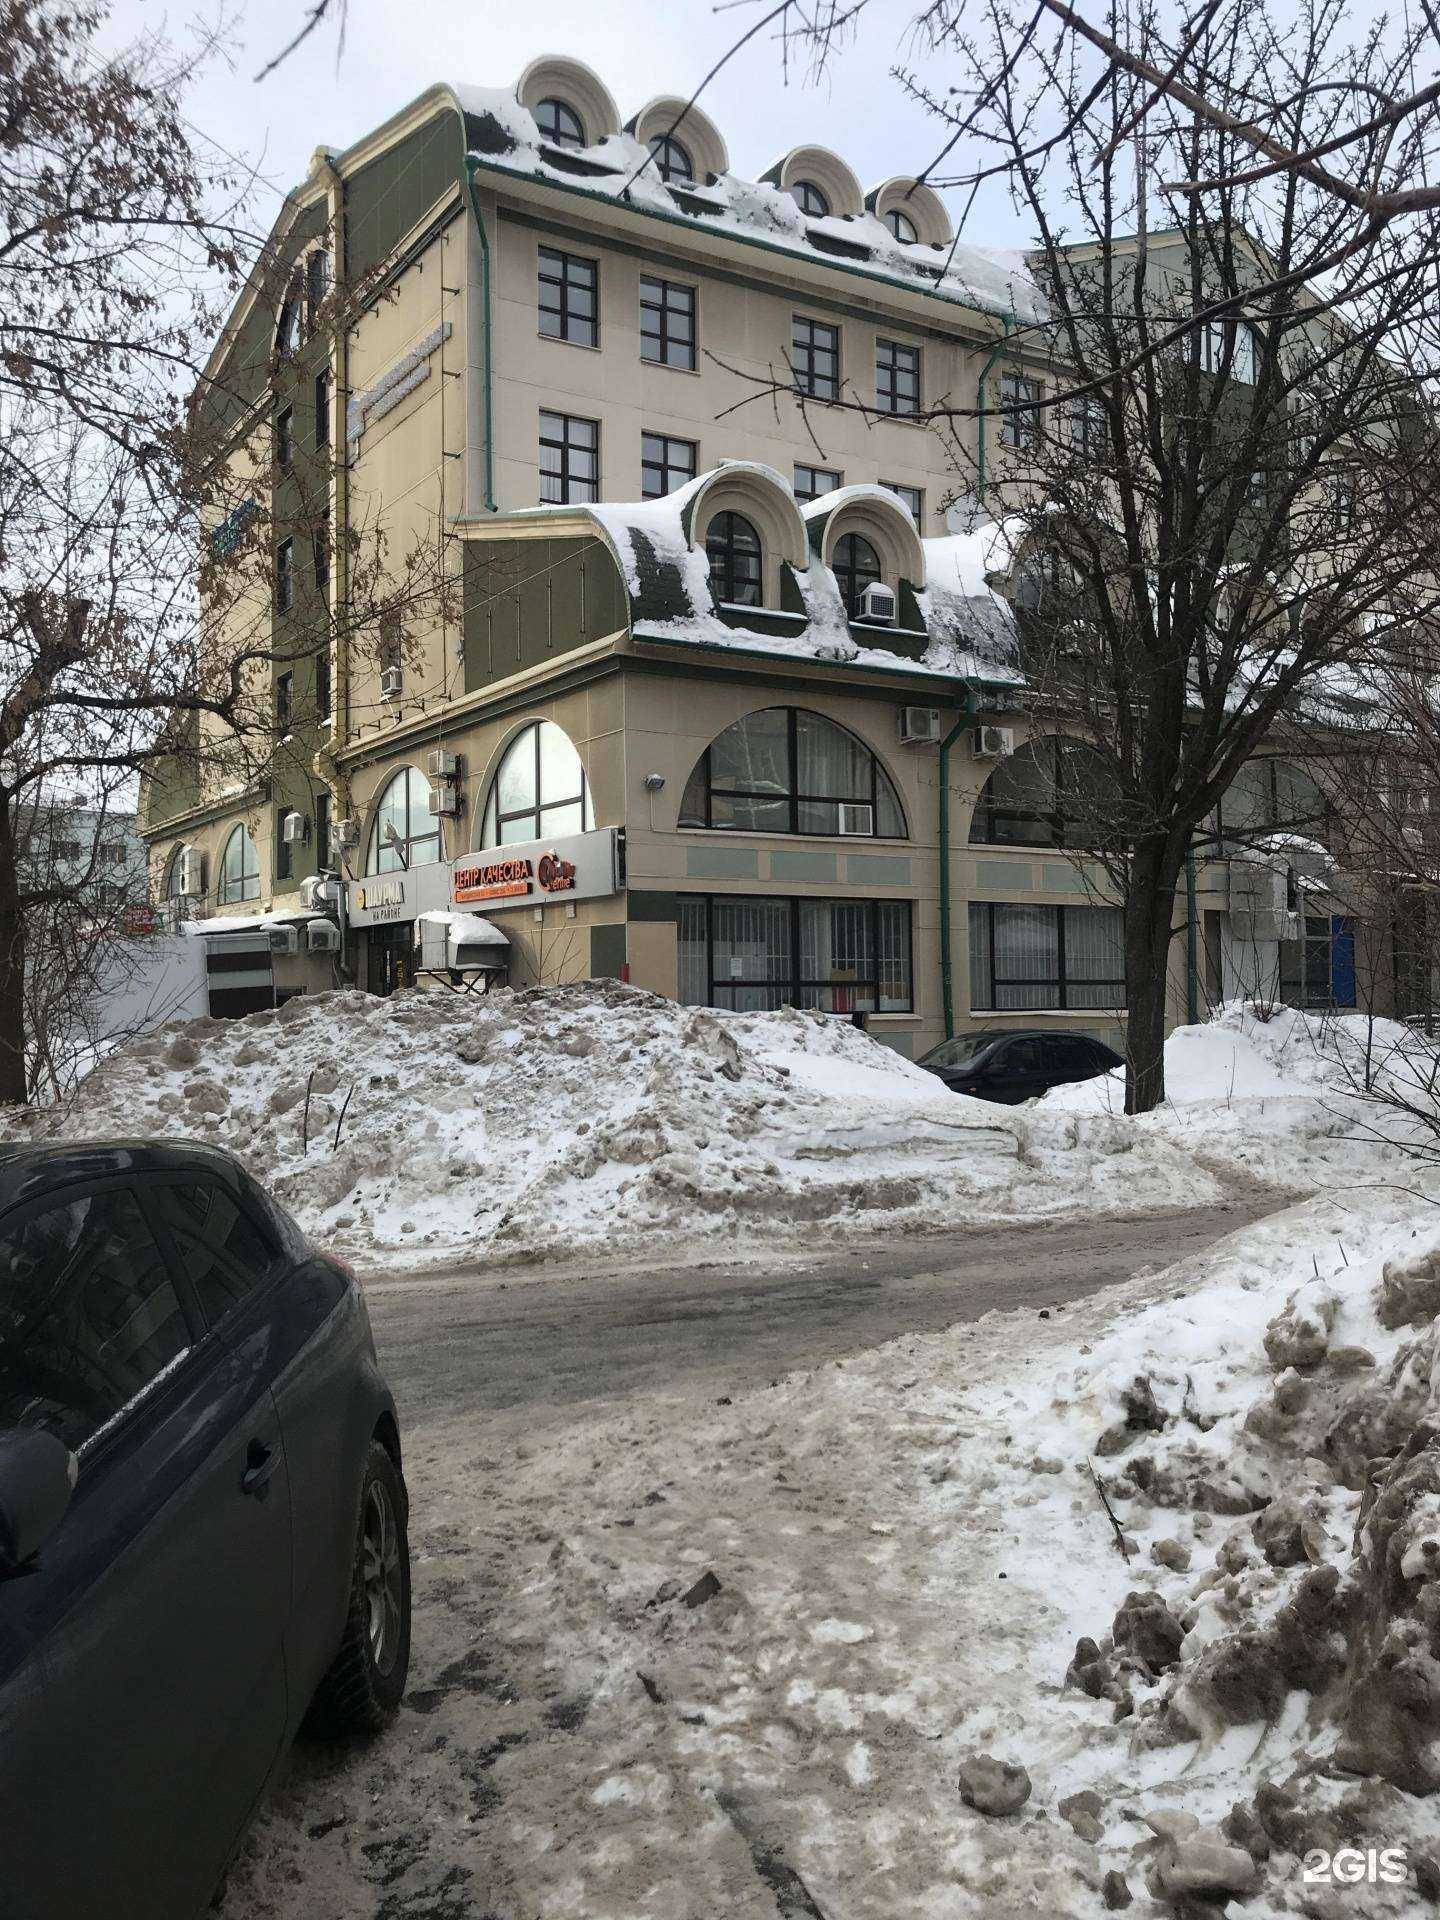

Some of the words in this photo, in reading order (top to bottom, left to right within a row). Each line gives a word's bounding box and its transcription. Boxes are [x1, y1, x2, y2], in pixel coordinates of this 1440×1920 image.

[455, 866, 479, 888] ЦЕНТР
[481, 859, 530, 884] КАЧЕСТВА
[373, 910, 380, 921] НА
